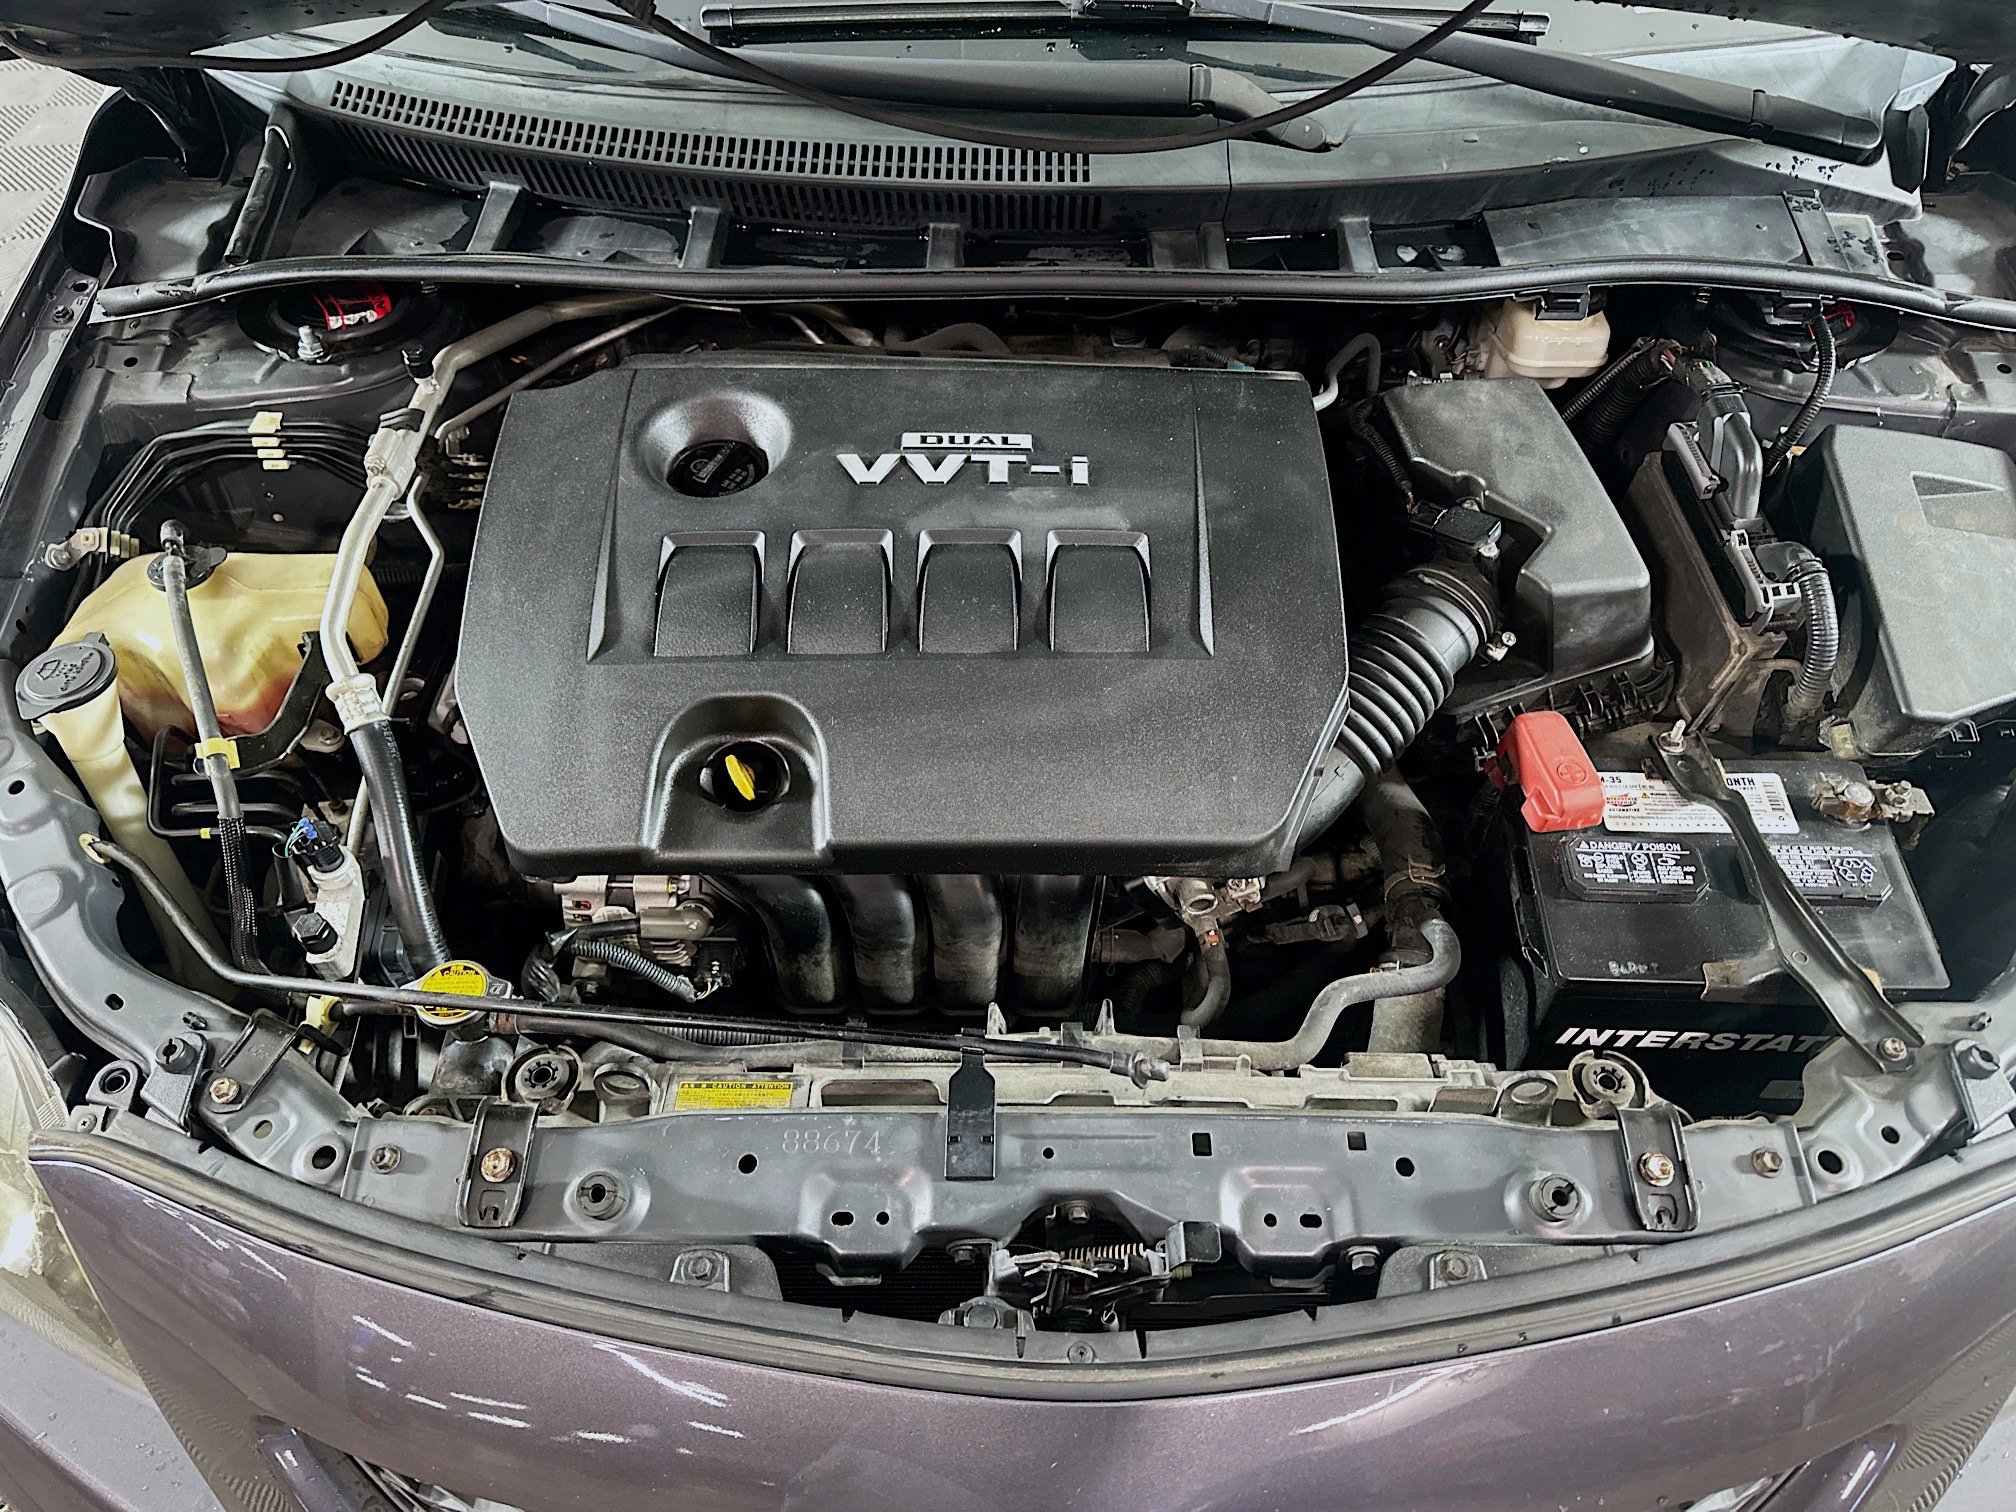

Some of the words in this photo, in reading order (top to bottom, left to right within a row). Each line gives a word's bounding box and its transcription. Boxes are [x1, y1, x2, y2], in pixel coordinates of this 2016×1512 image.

[919, 434, 1022, 447] DUAL
[836, 453, 1090, 487] VVT-i
[1725, 777, 1756, 787] ONTH
[1590, 841, 1632, 850] DANGER
[1641, 842, 1681, 851] POISON
[782, 1128, 881, 1155] 88674
